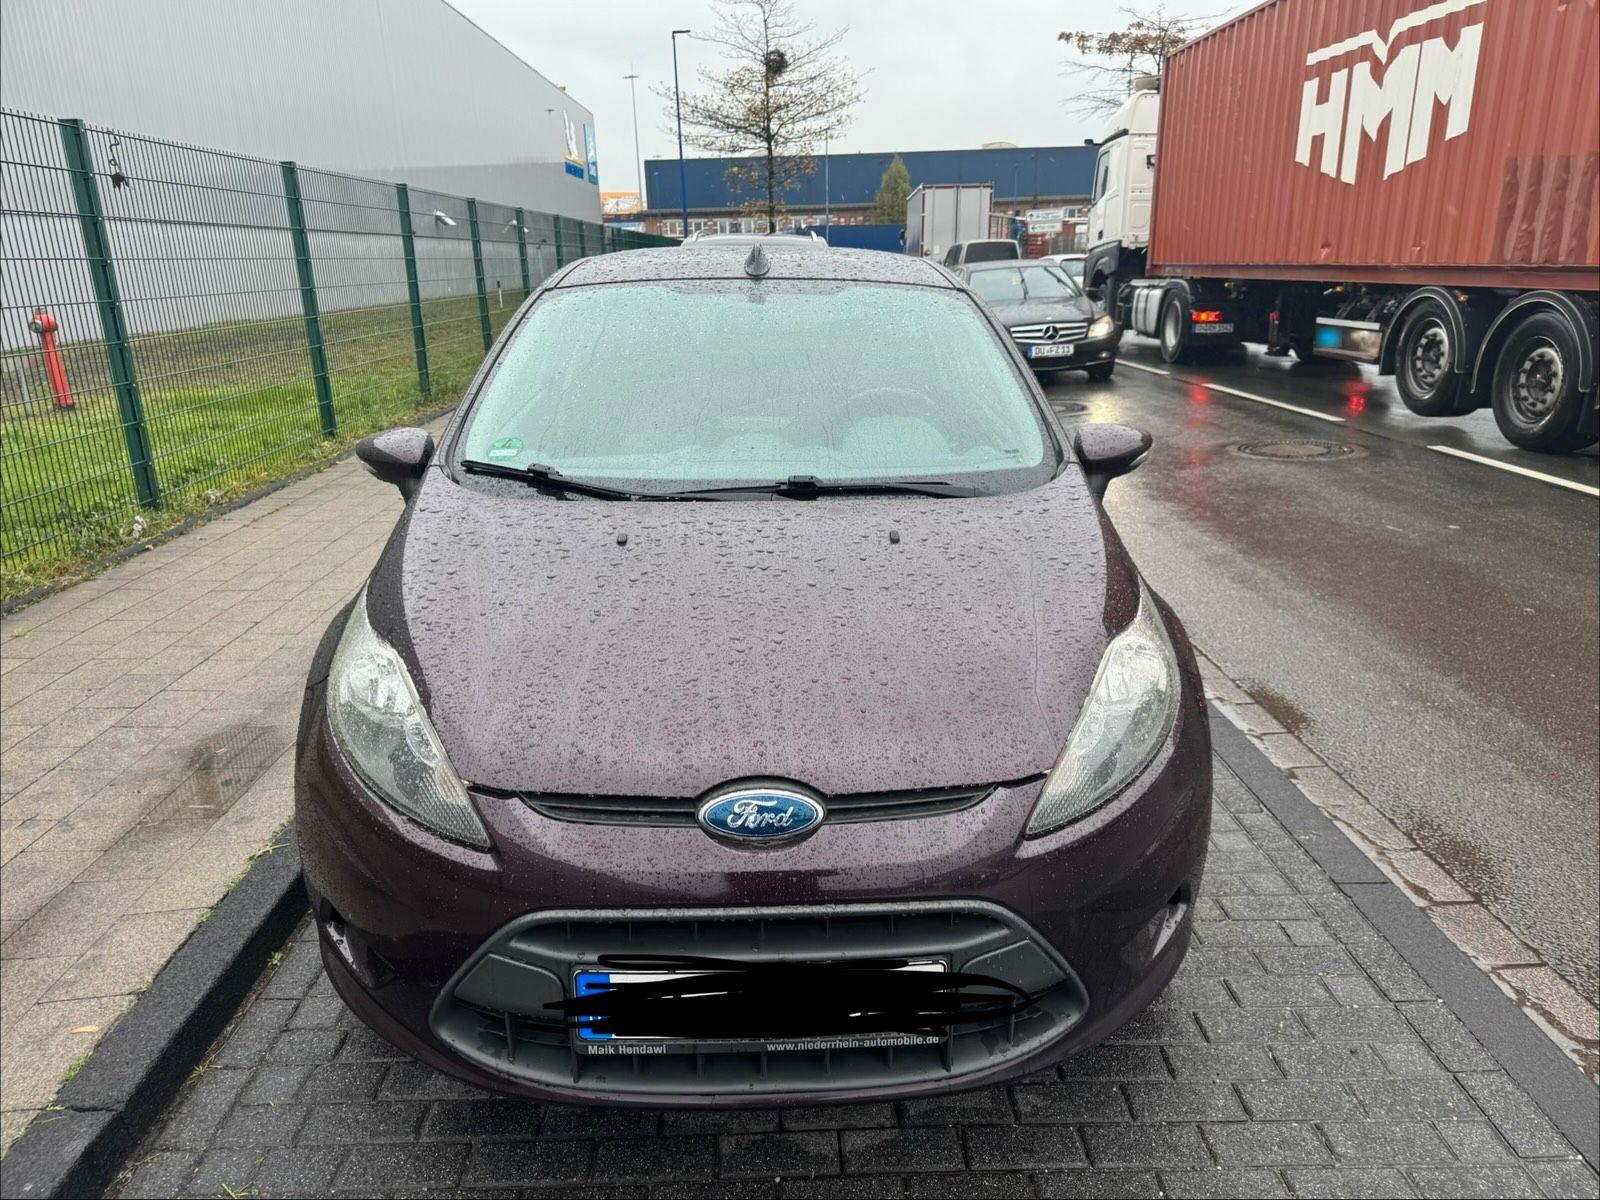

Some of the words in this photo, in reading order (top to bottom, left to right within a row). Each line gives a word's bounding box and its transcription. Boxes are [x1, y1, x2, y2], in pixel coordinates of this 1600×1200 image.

[1295, 21, 1484, 185] HMM
[726, 799, 795, 829] Ford
[587, 1044, 616, 1055] Maik
[618, 1044, 667, 1054] Hendawi
[766, 1035, 940, 1051] www.niederrhein-automobile.de
